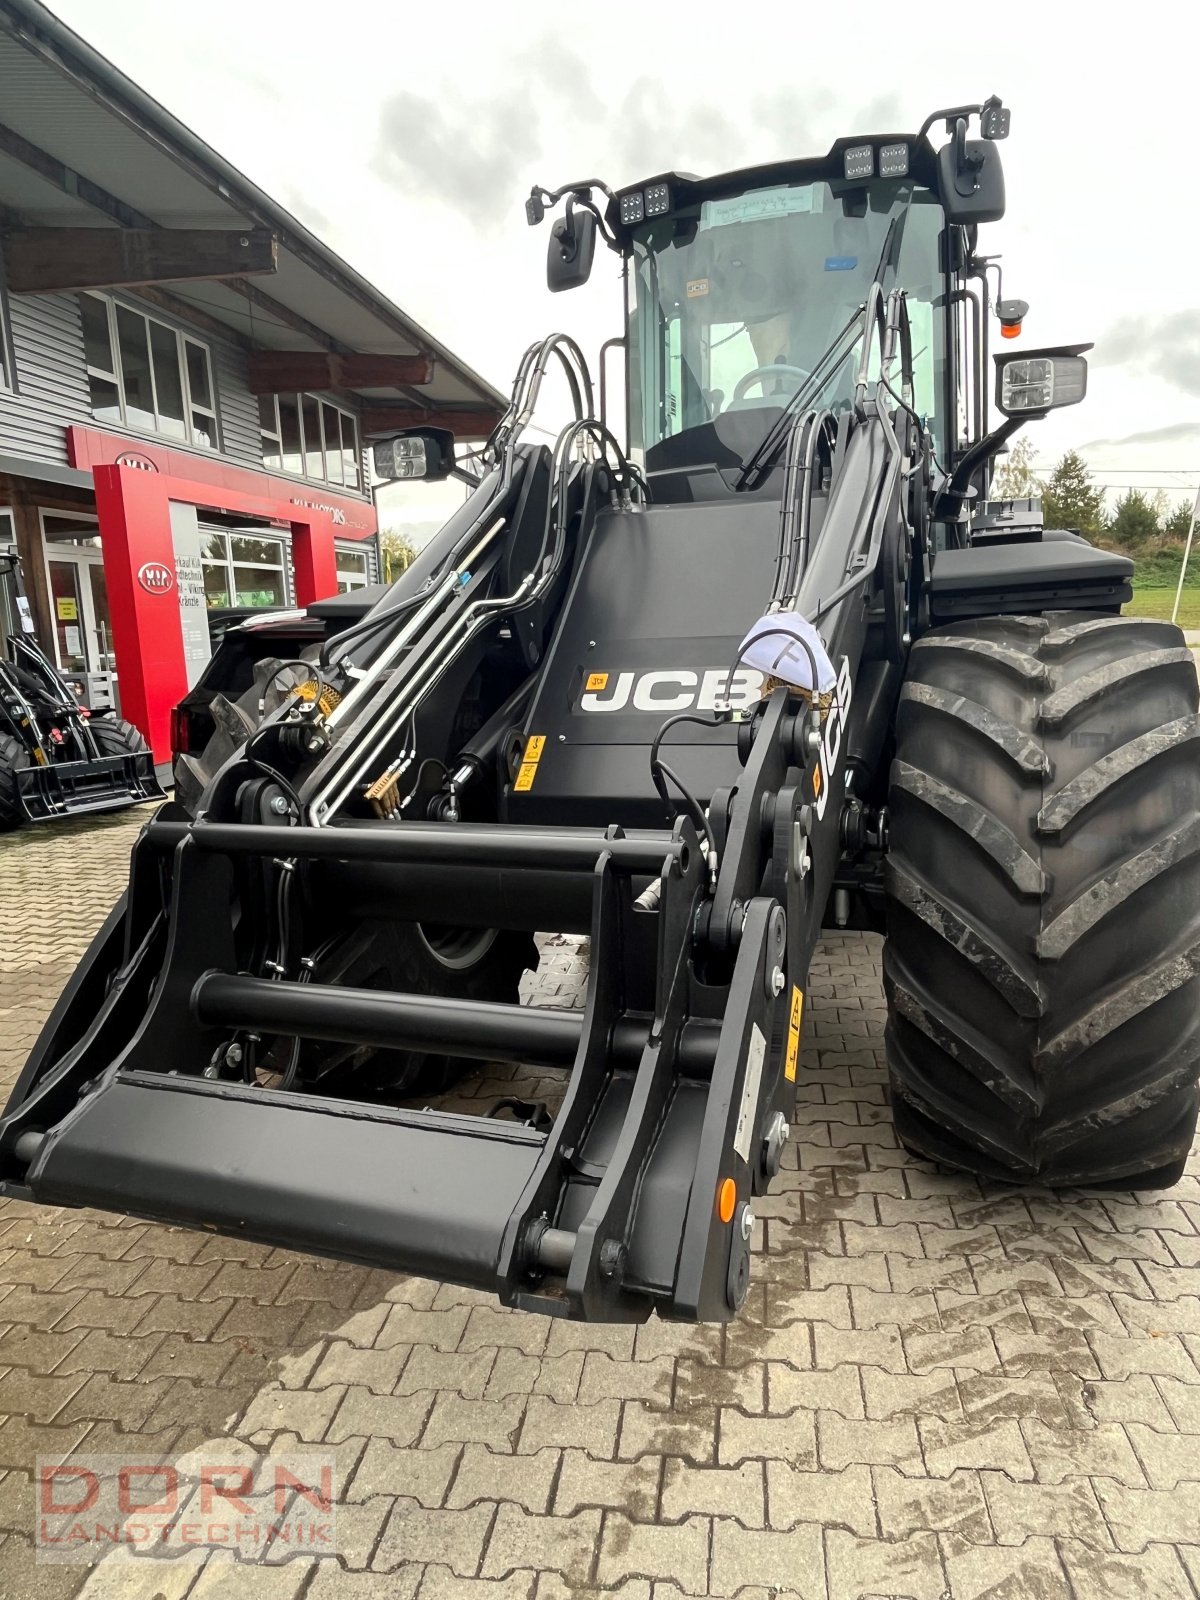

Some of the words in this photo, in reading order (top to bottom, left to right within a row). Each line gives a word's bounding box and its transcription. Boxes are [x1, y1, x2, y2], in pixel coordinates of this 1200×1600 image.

[687, 283, 708, 293] JCB
[144, 569, 170, 588] KIA
[581, 671, 764, 712] JCB
[816, 655, 852, 821] JCB
